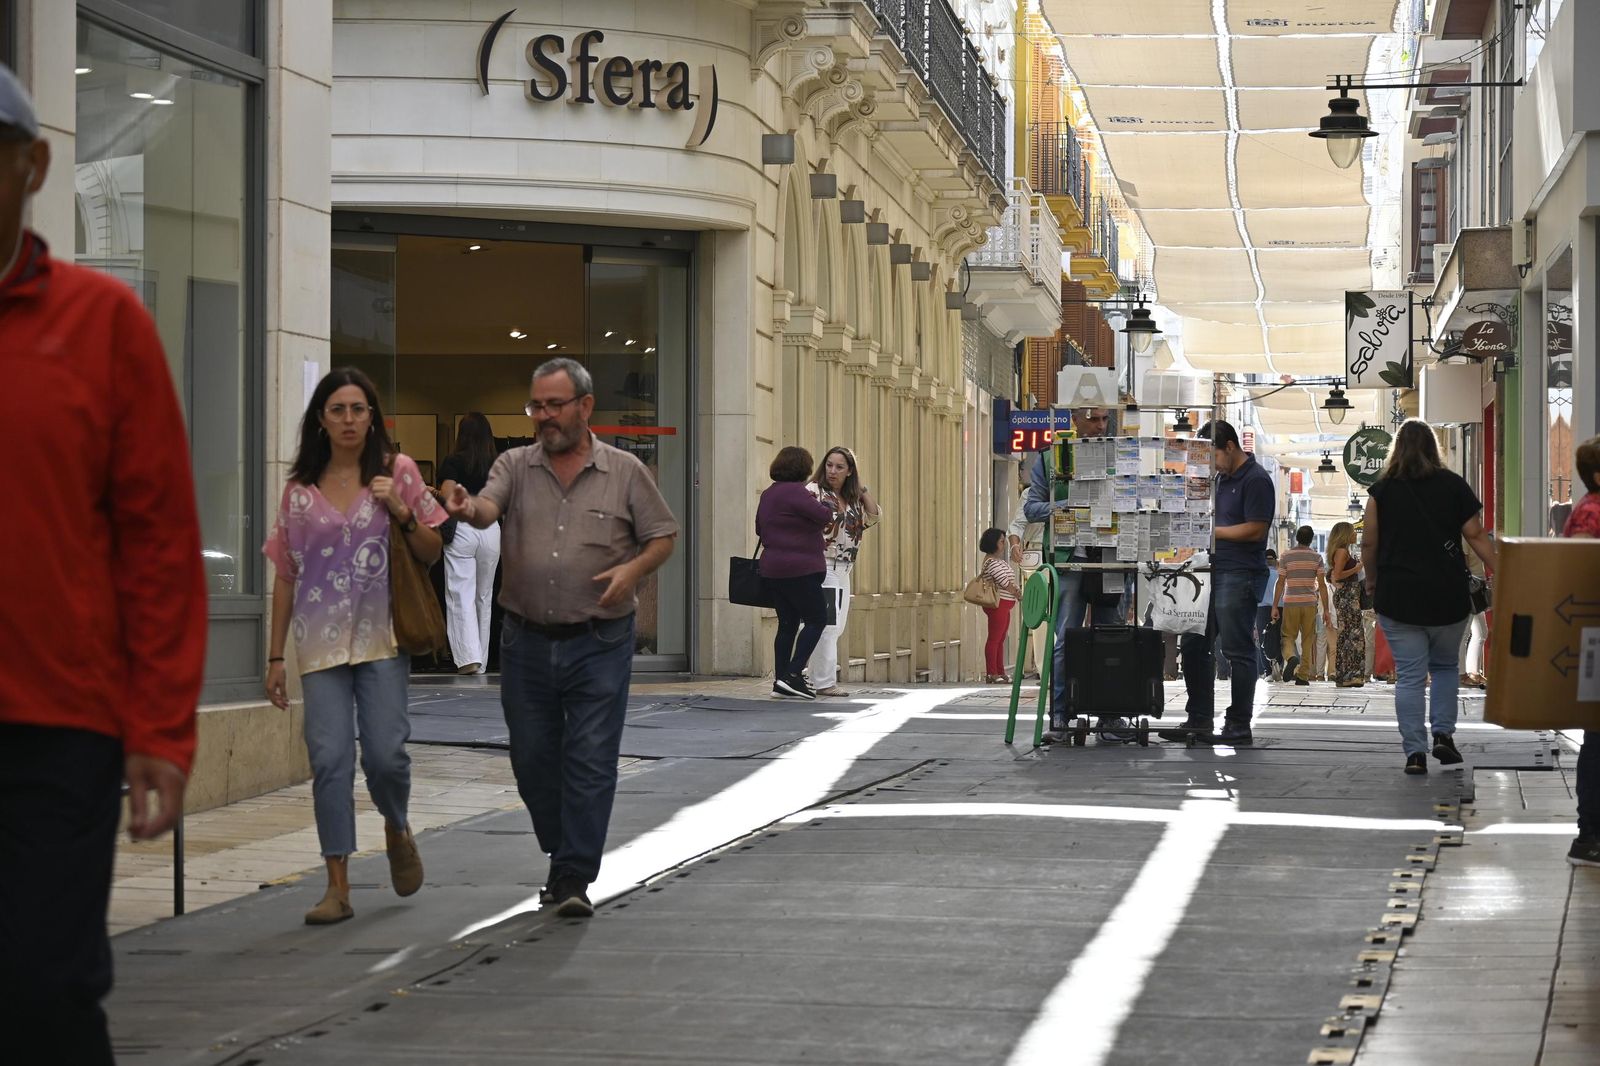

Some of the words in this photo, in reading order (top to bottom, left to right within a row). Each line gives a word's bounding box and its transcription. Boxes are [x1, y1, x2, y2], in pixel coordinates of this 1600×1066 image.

[526, 29, 695, 111] Sfera
[1476, 322, 1495, 335] La
[1012, 415, 1037, 425] óptica
